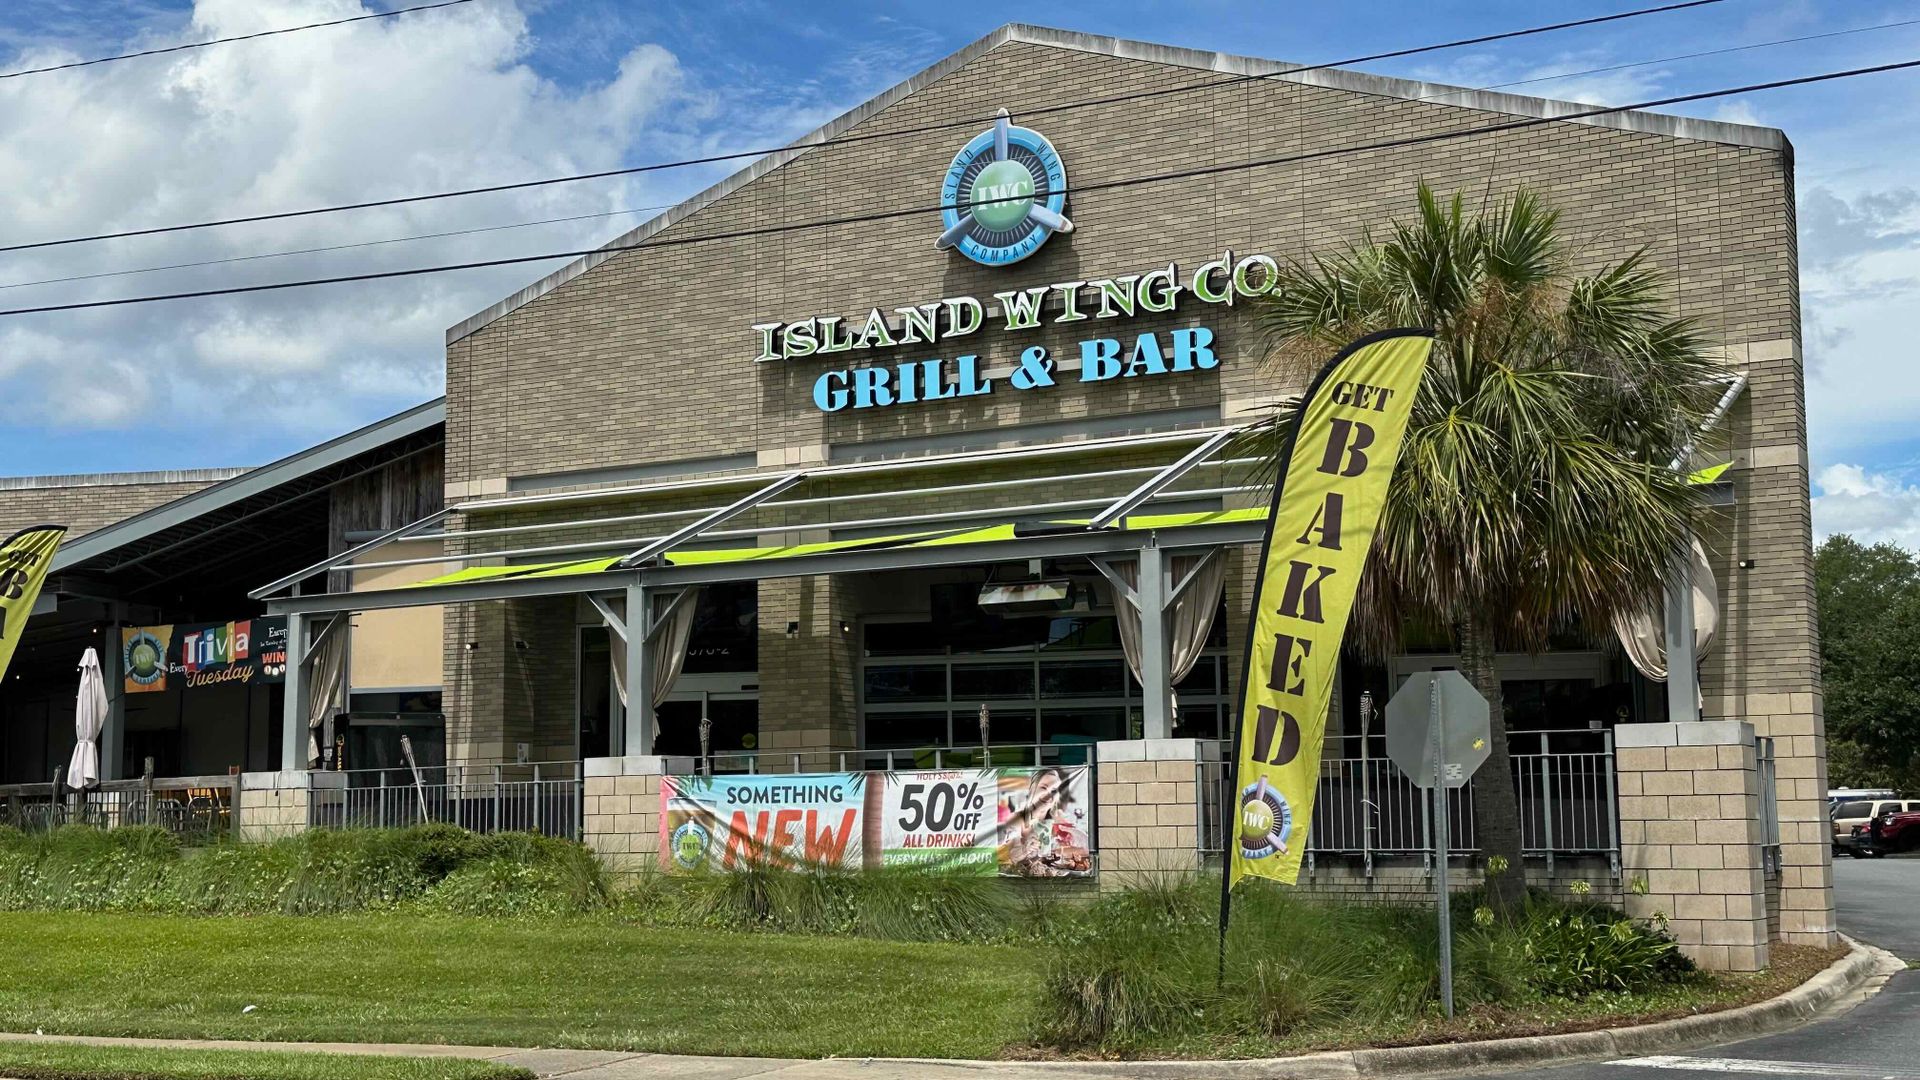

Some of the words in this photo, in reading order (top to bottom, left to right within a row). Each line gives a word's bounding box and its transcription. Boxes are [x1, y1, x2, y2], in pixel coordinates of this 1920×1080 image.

[944, 149, 975, 207] SLAND
[1037, 142, 1061, 182] WING
[977, 180, 1029, 211] IWC
[970, 235, 1041, 261] COMPANY
[752, 295, 984, 363] ISLAND
[993, 262, 1184, 332] WING
[813, 354, 992, 413] GRILL
[1010, 345, 1055, 390] &
[1078, 326, 1221, 383] BAR
[1331, 381, 1396, 413] GET
[1250, 416, 1377, 767] BAKED
[184, 630, 249, 665] Trivia
[186, 662, 254, 688] Tuesday
[727, 785, 843, 804] SOMETHING
[898, 782, 984, 832] 50%
[953, 813, 982, 831] OFF
[1242, 811, 1269, 831] IWC
[722, 808, 858, 871] NEW
[903, 834, 924, 848] ALL
[926, 833, 976, 848] DRINKS!
[881, 853, 917, 866] EVERY
[958, 852, 993, 865] HOUR
